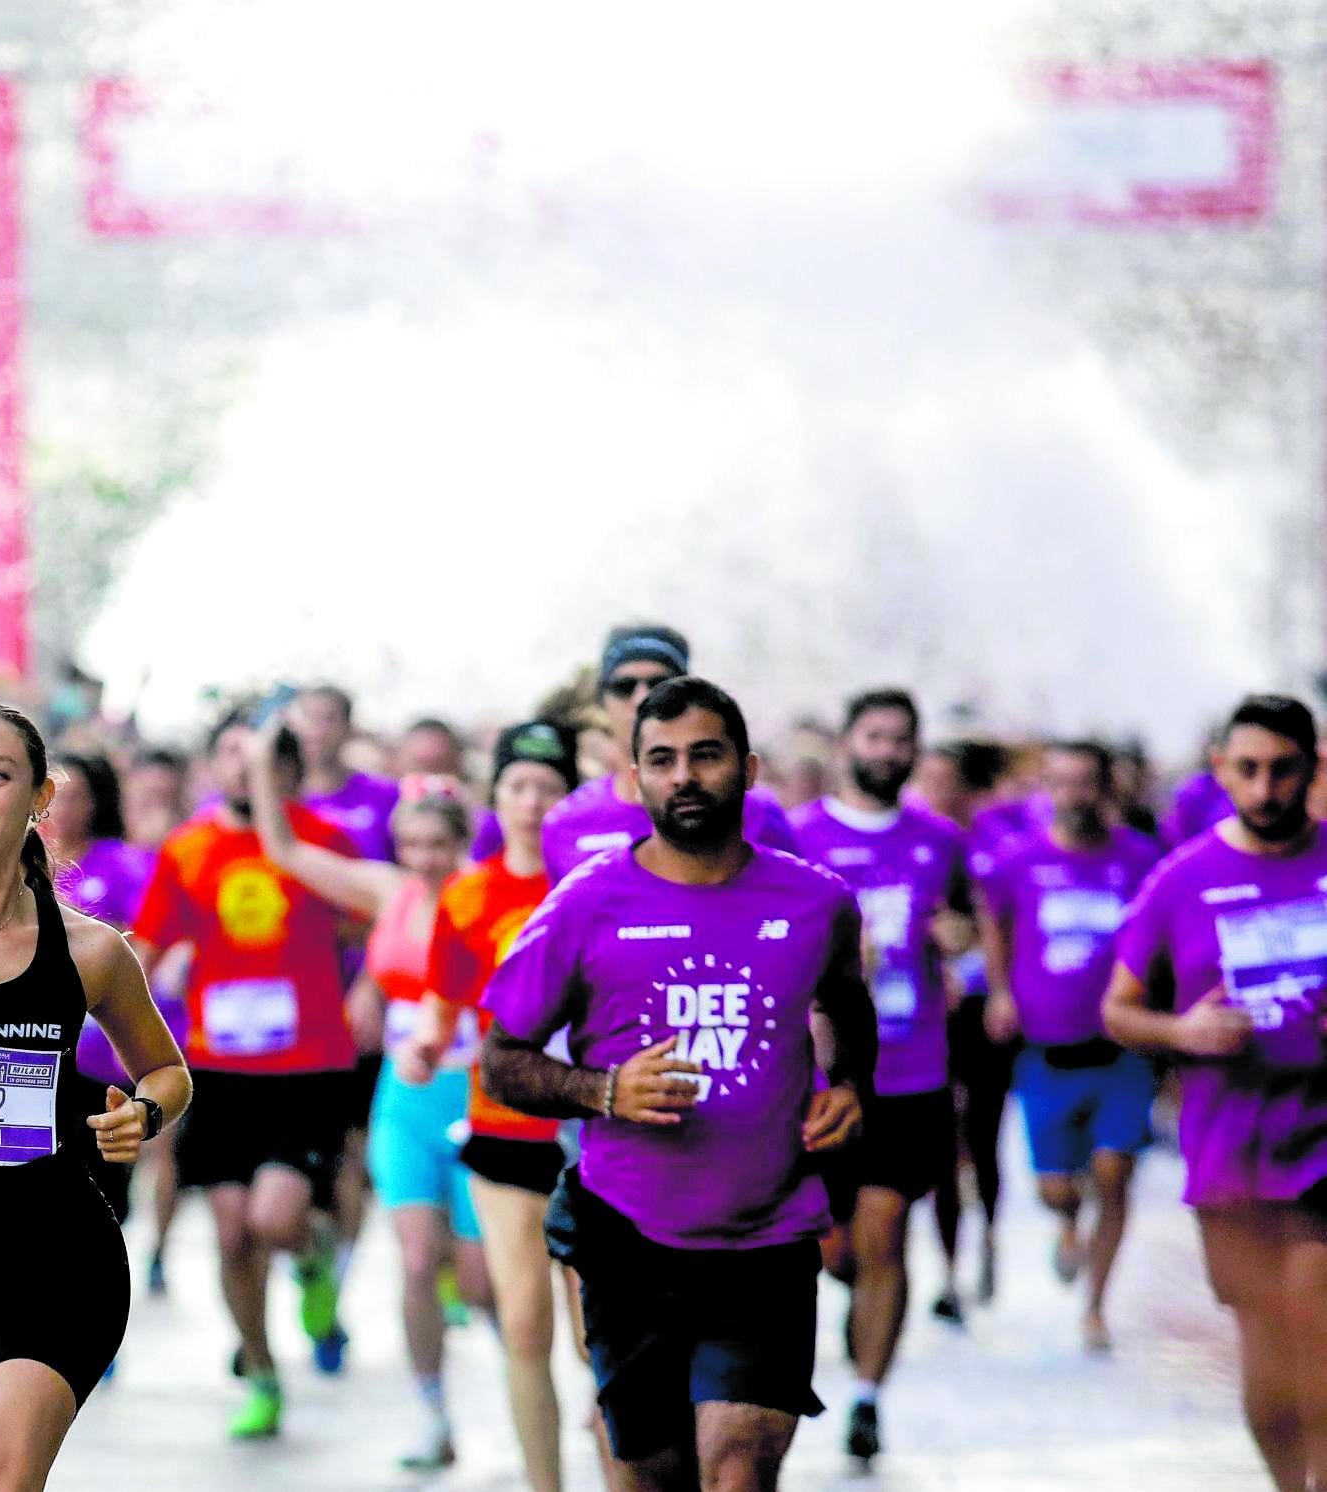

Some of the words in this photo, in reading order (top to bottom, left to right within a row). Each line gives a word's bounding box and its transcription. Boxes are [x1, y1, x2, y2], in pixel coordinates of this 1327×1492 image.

[666, 983, 751, 1028] DEE
[12, 1066, 48, 1075] MILANO
[665, 1027, 748, 1071] JAY
